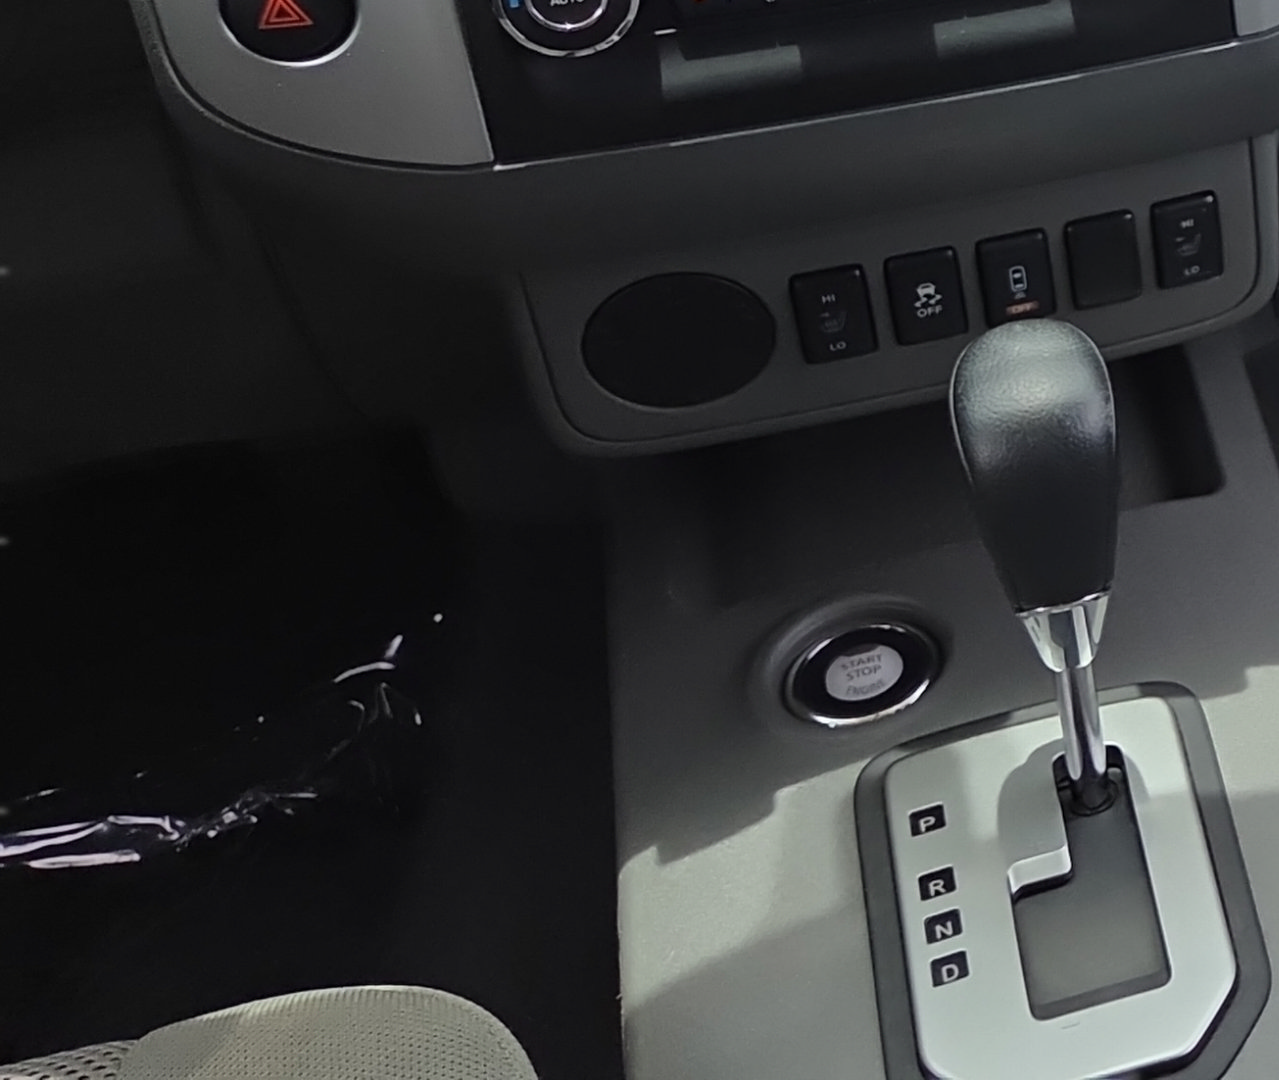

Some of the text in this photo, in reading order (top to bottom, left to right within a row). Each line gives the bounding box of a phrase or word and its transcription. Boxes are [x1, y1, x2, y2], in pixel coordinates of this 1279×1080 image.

[1184, 265, 1200, 276] LO
[821, 294, 836, 304] HI
[917, 305, 943, 318] OFF
[829, 341, 847, 351] LO
[841, 654, 882, 670] START
[846, 665, 881, 681] STOP
[919, 816, 935, 833] P
[928, 879, 945, 897] R
[935, 922, 953, 939] N
[941, 964, 959, 982] D
